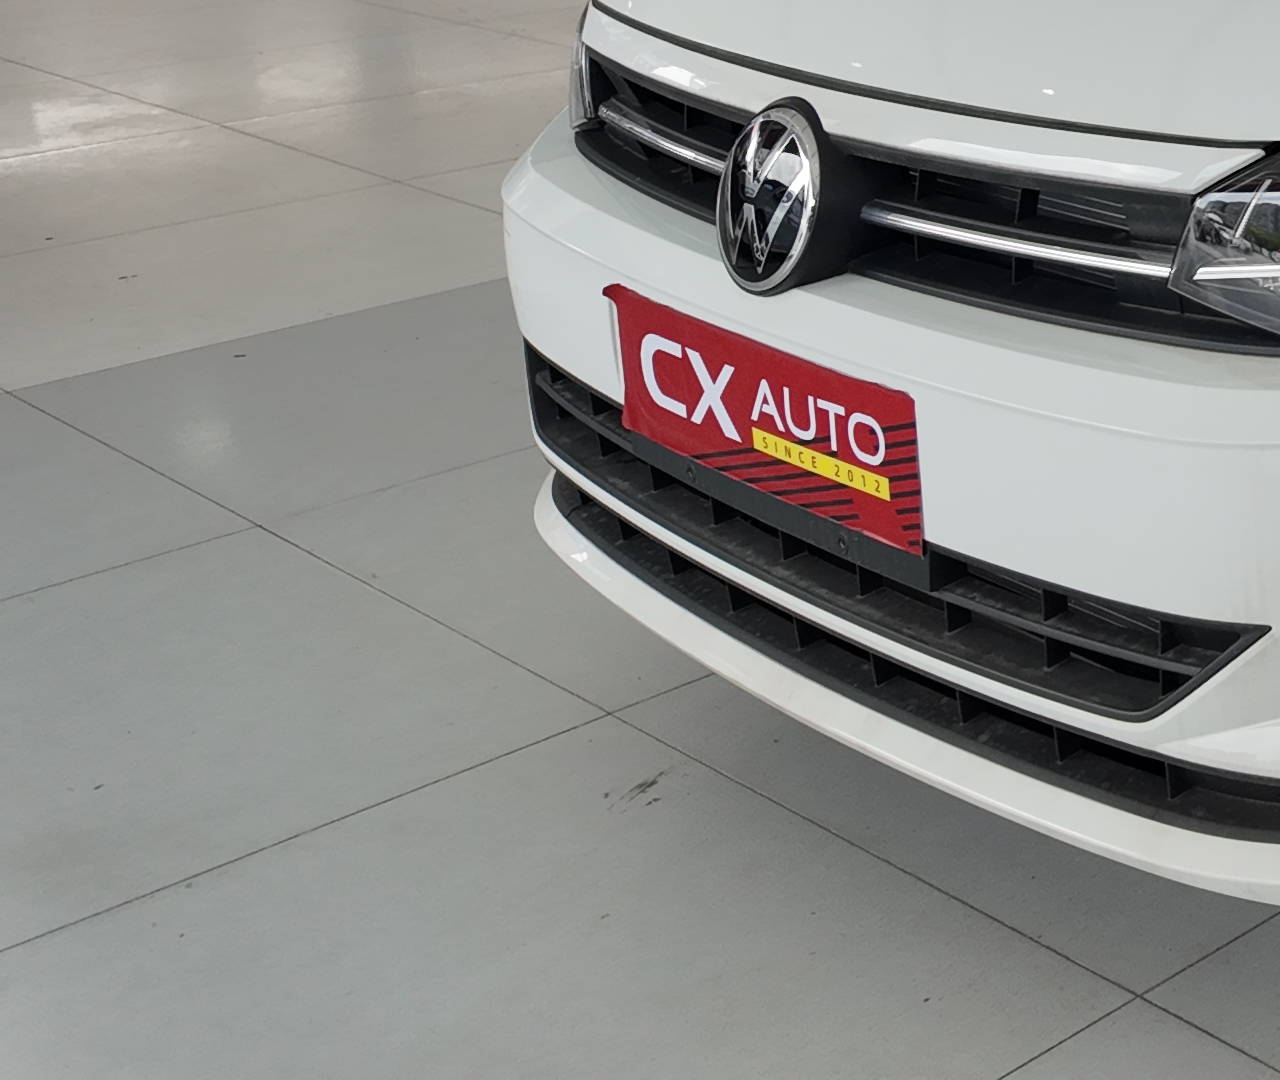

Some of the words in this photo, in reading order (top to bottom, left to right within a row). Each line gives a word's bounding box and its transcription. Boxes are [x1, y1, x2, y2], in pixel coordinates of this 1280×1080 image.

[640, 332, 743, 444] CX
[750, 377, 887, 467] AUTO
[762, 436, 819, 470] SINCE
[834, 464, 882, 495] 2012
